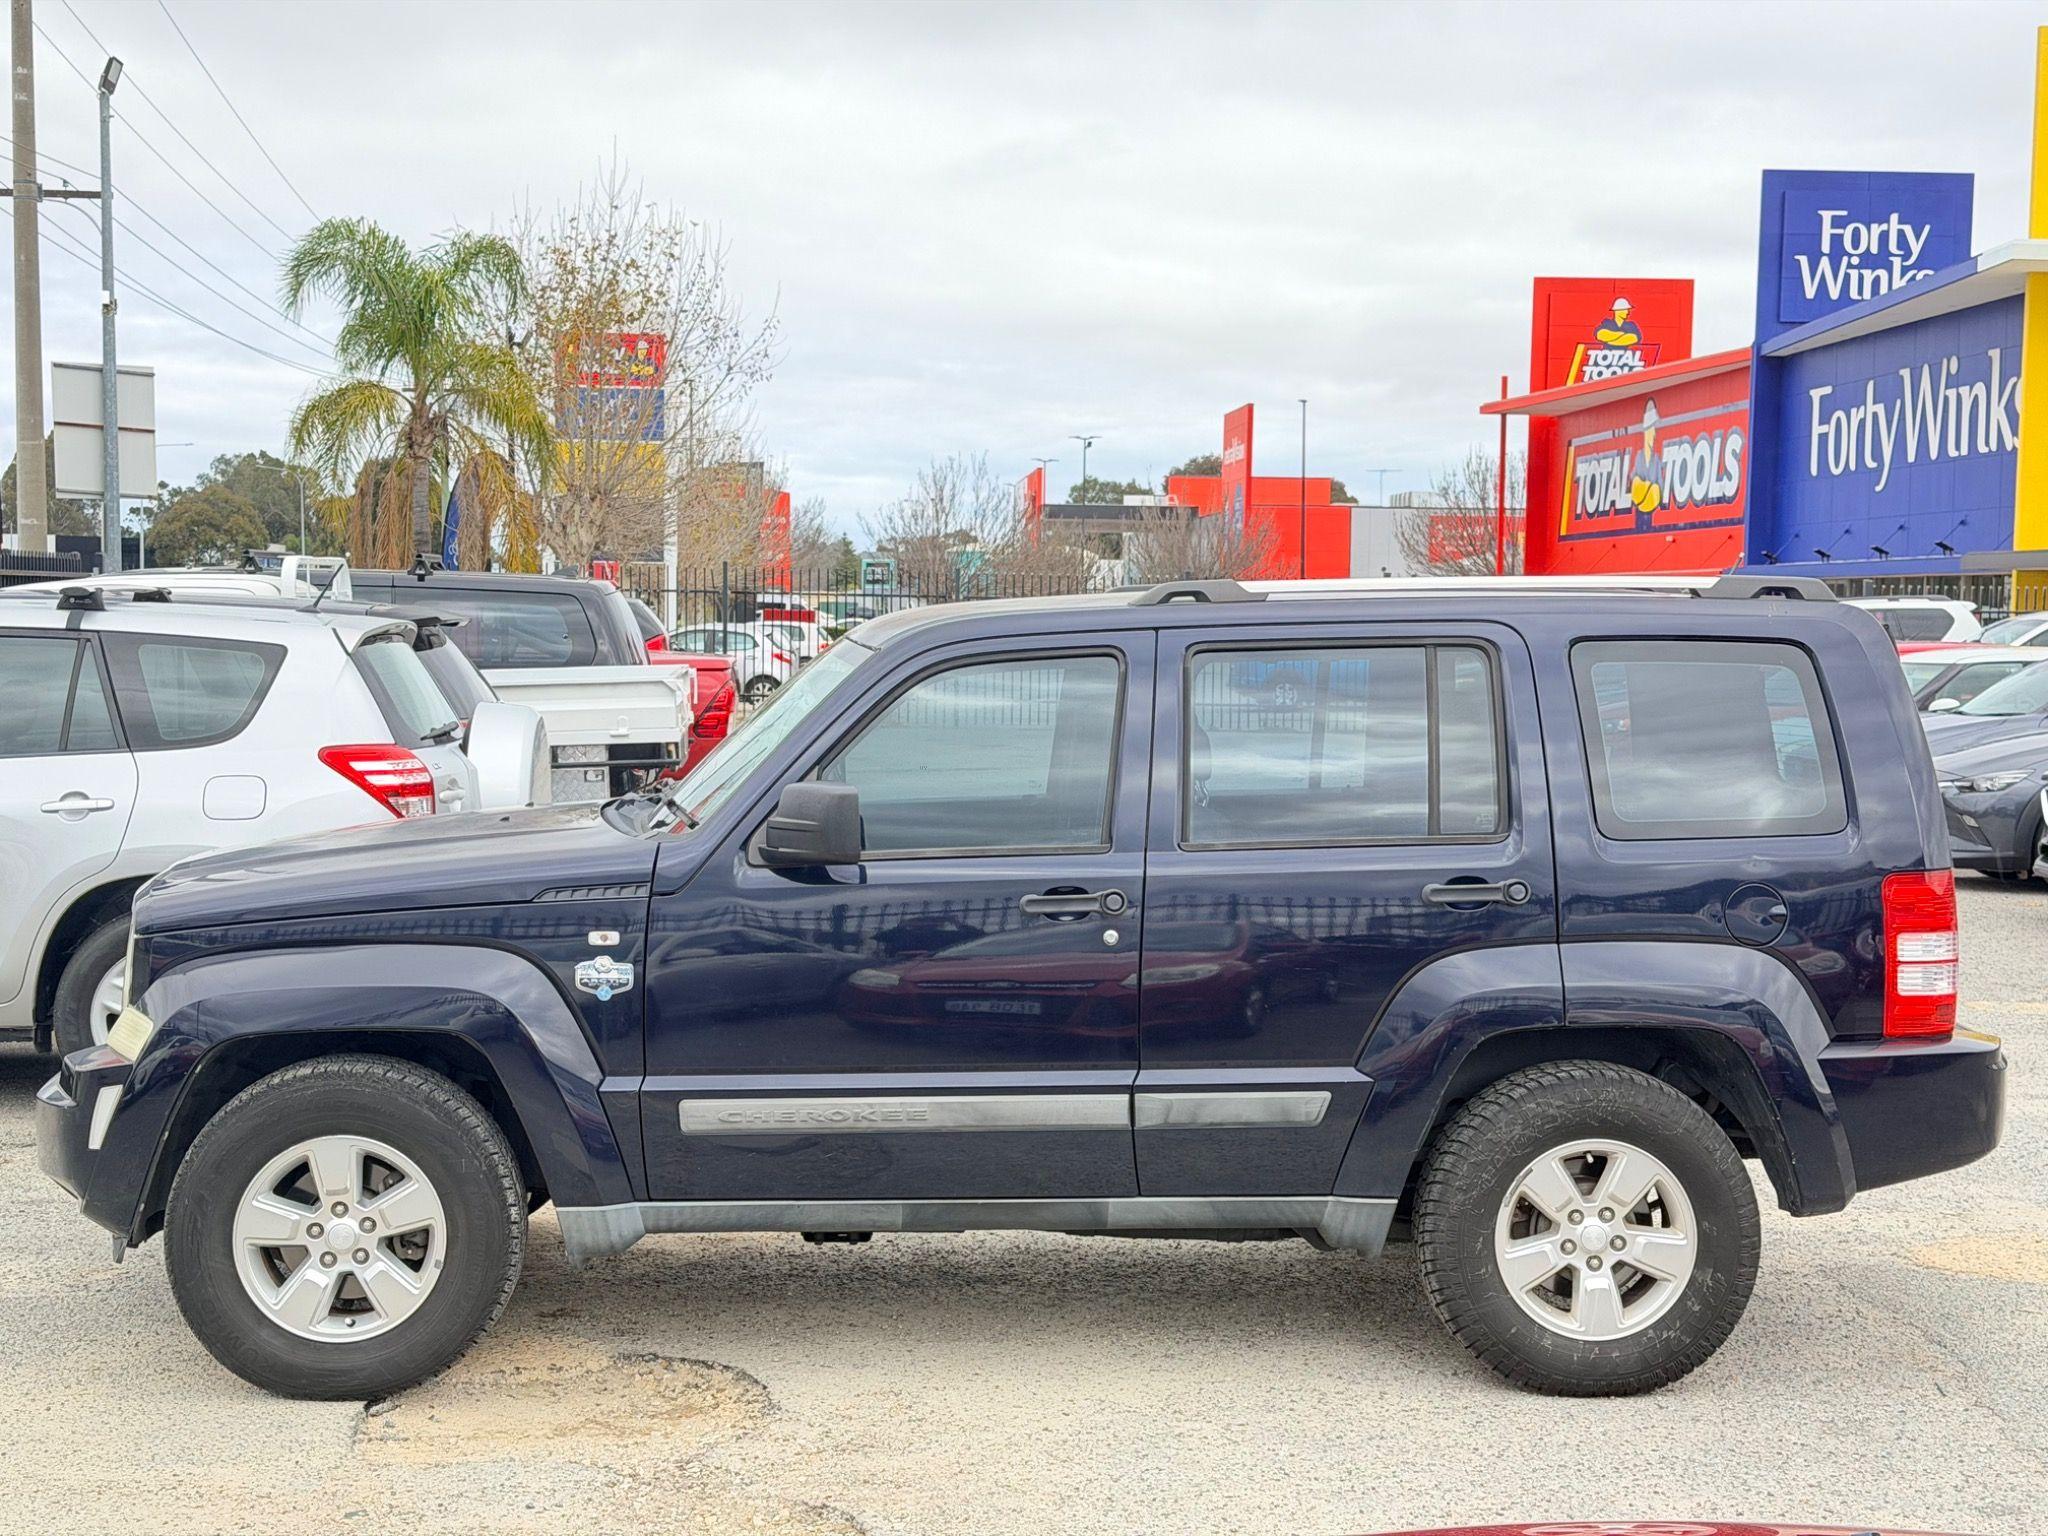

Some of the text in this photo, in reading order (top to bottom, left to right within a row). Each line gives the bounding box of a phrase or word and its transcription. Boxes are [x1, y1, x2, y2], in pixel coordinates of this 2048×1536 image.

[1817, 209, 1931, 266] Forty
[1794, 255, 1935, 300] Wink
[1586, 349, 1645, 366] TOTAL
[1575, 432, 1743, 516] TOTAL TOOLS
[717, 1108, 929, 1123] CHEROKEE
